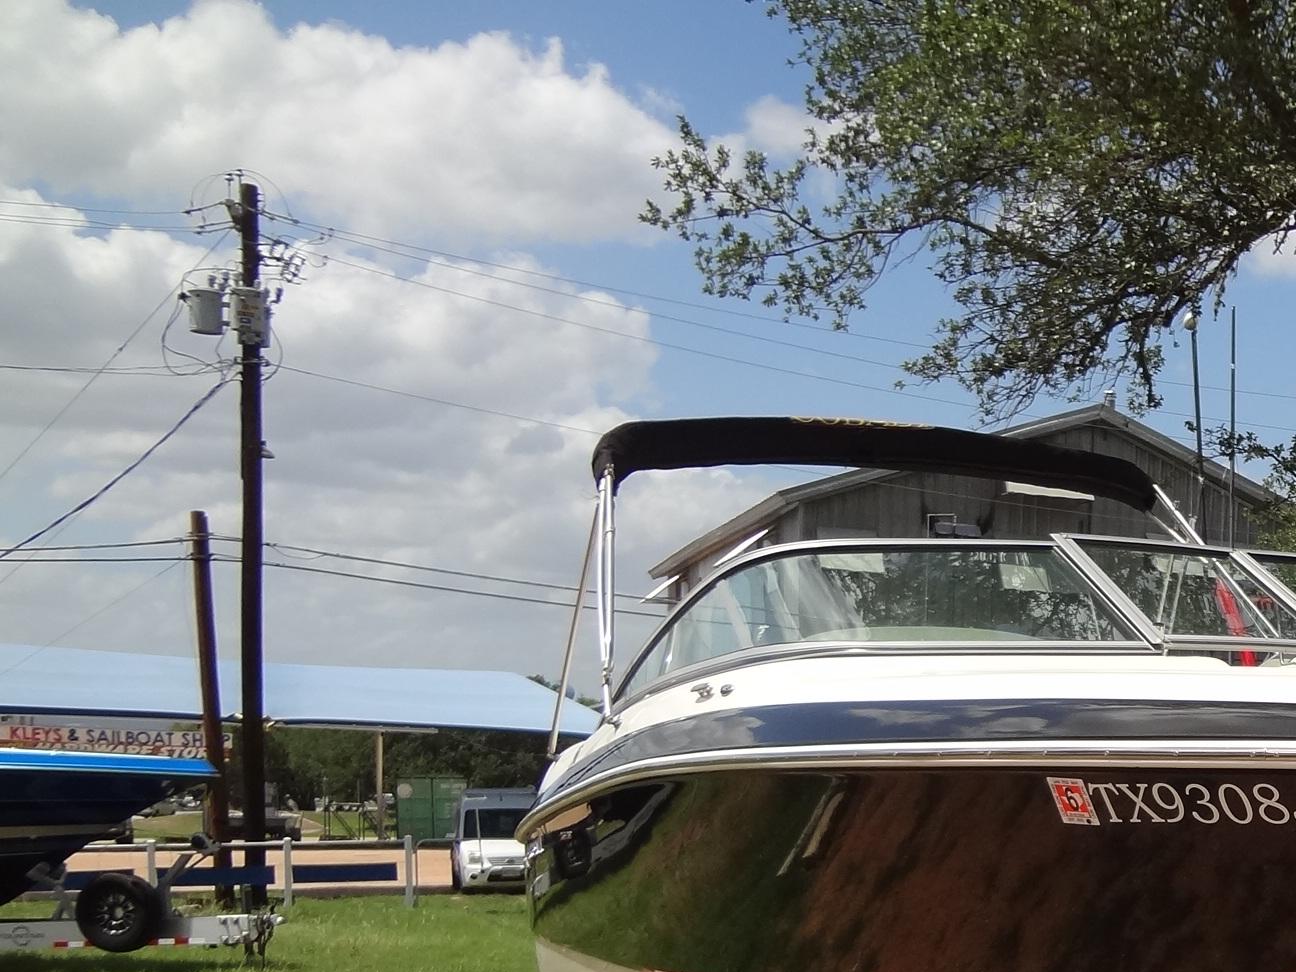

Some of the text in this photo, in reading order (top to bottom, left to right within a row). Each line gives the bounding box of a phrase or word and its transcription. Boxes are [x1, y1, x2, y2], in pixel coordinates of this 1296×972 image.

[9, 726, 231, 748] KLEYS & SAILBOAT SHP
